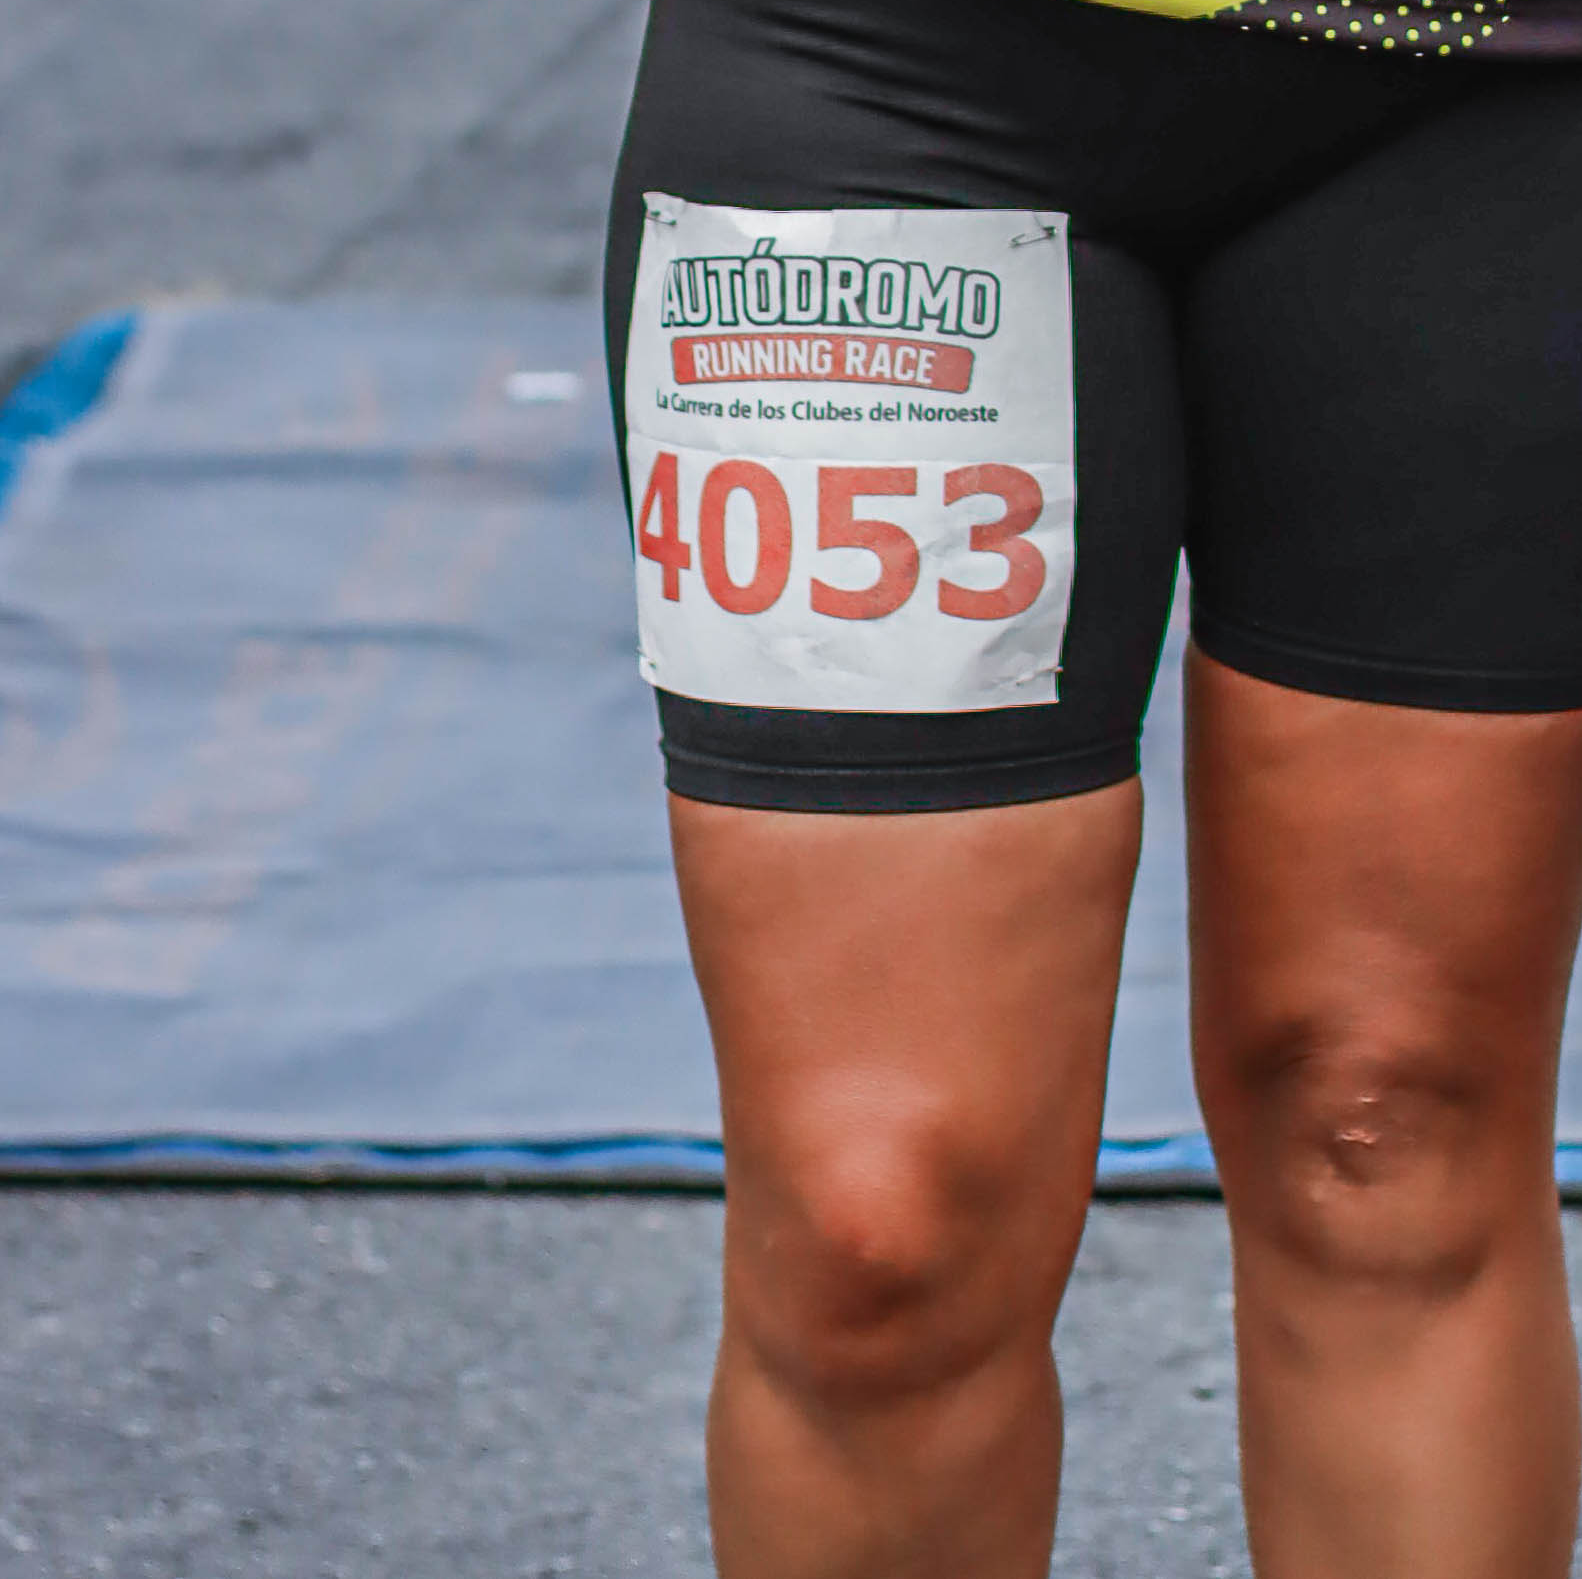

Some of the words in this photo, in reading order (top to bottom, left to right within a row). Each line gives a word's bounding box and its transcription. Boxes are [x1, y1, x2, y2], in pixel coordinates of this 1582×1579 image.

[660, 237, 1001, 339] AUTÓDROMO
[691, 338, 833, 379] RUNNING
[843, 343, 937, 385] RACE
[655, 388, 669, 410] La
[671, 392, 724, 417] Carrera
[728, 398, 751, 419] de
[757, 398, 786, 420] los
[791, 399, 864, 422] Clubes
[868, 401, 902, 423] del
[907, 402, 1000, 424] Noroeste
[638, 451, 1048, 621] 4053
